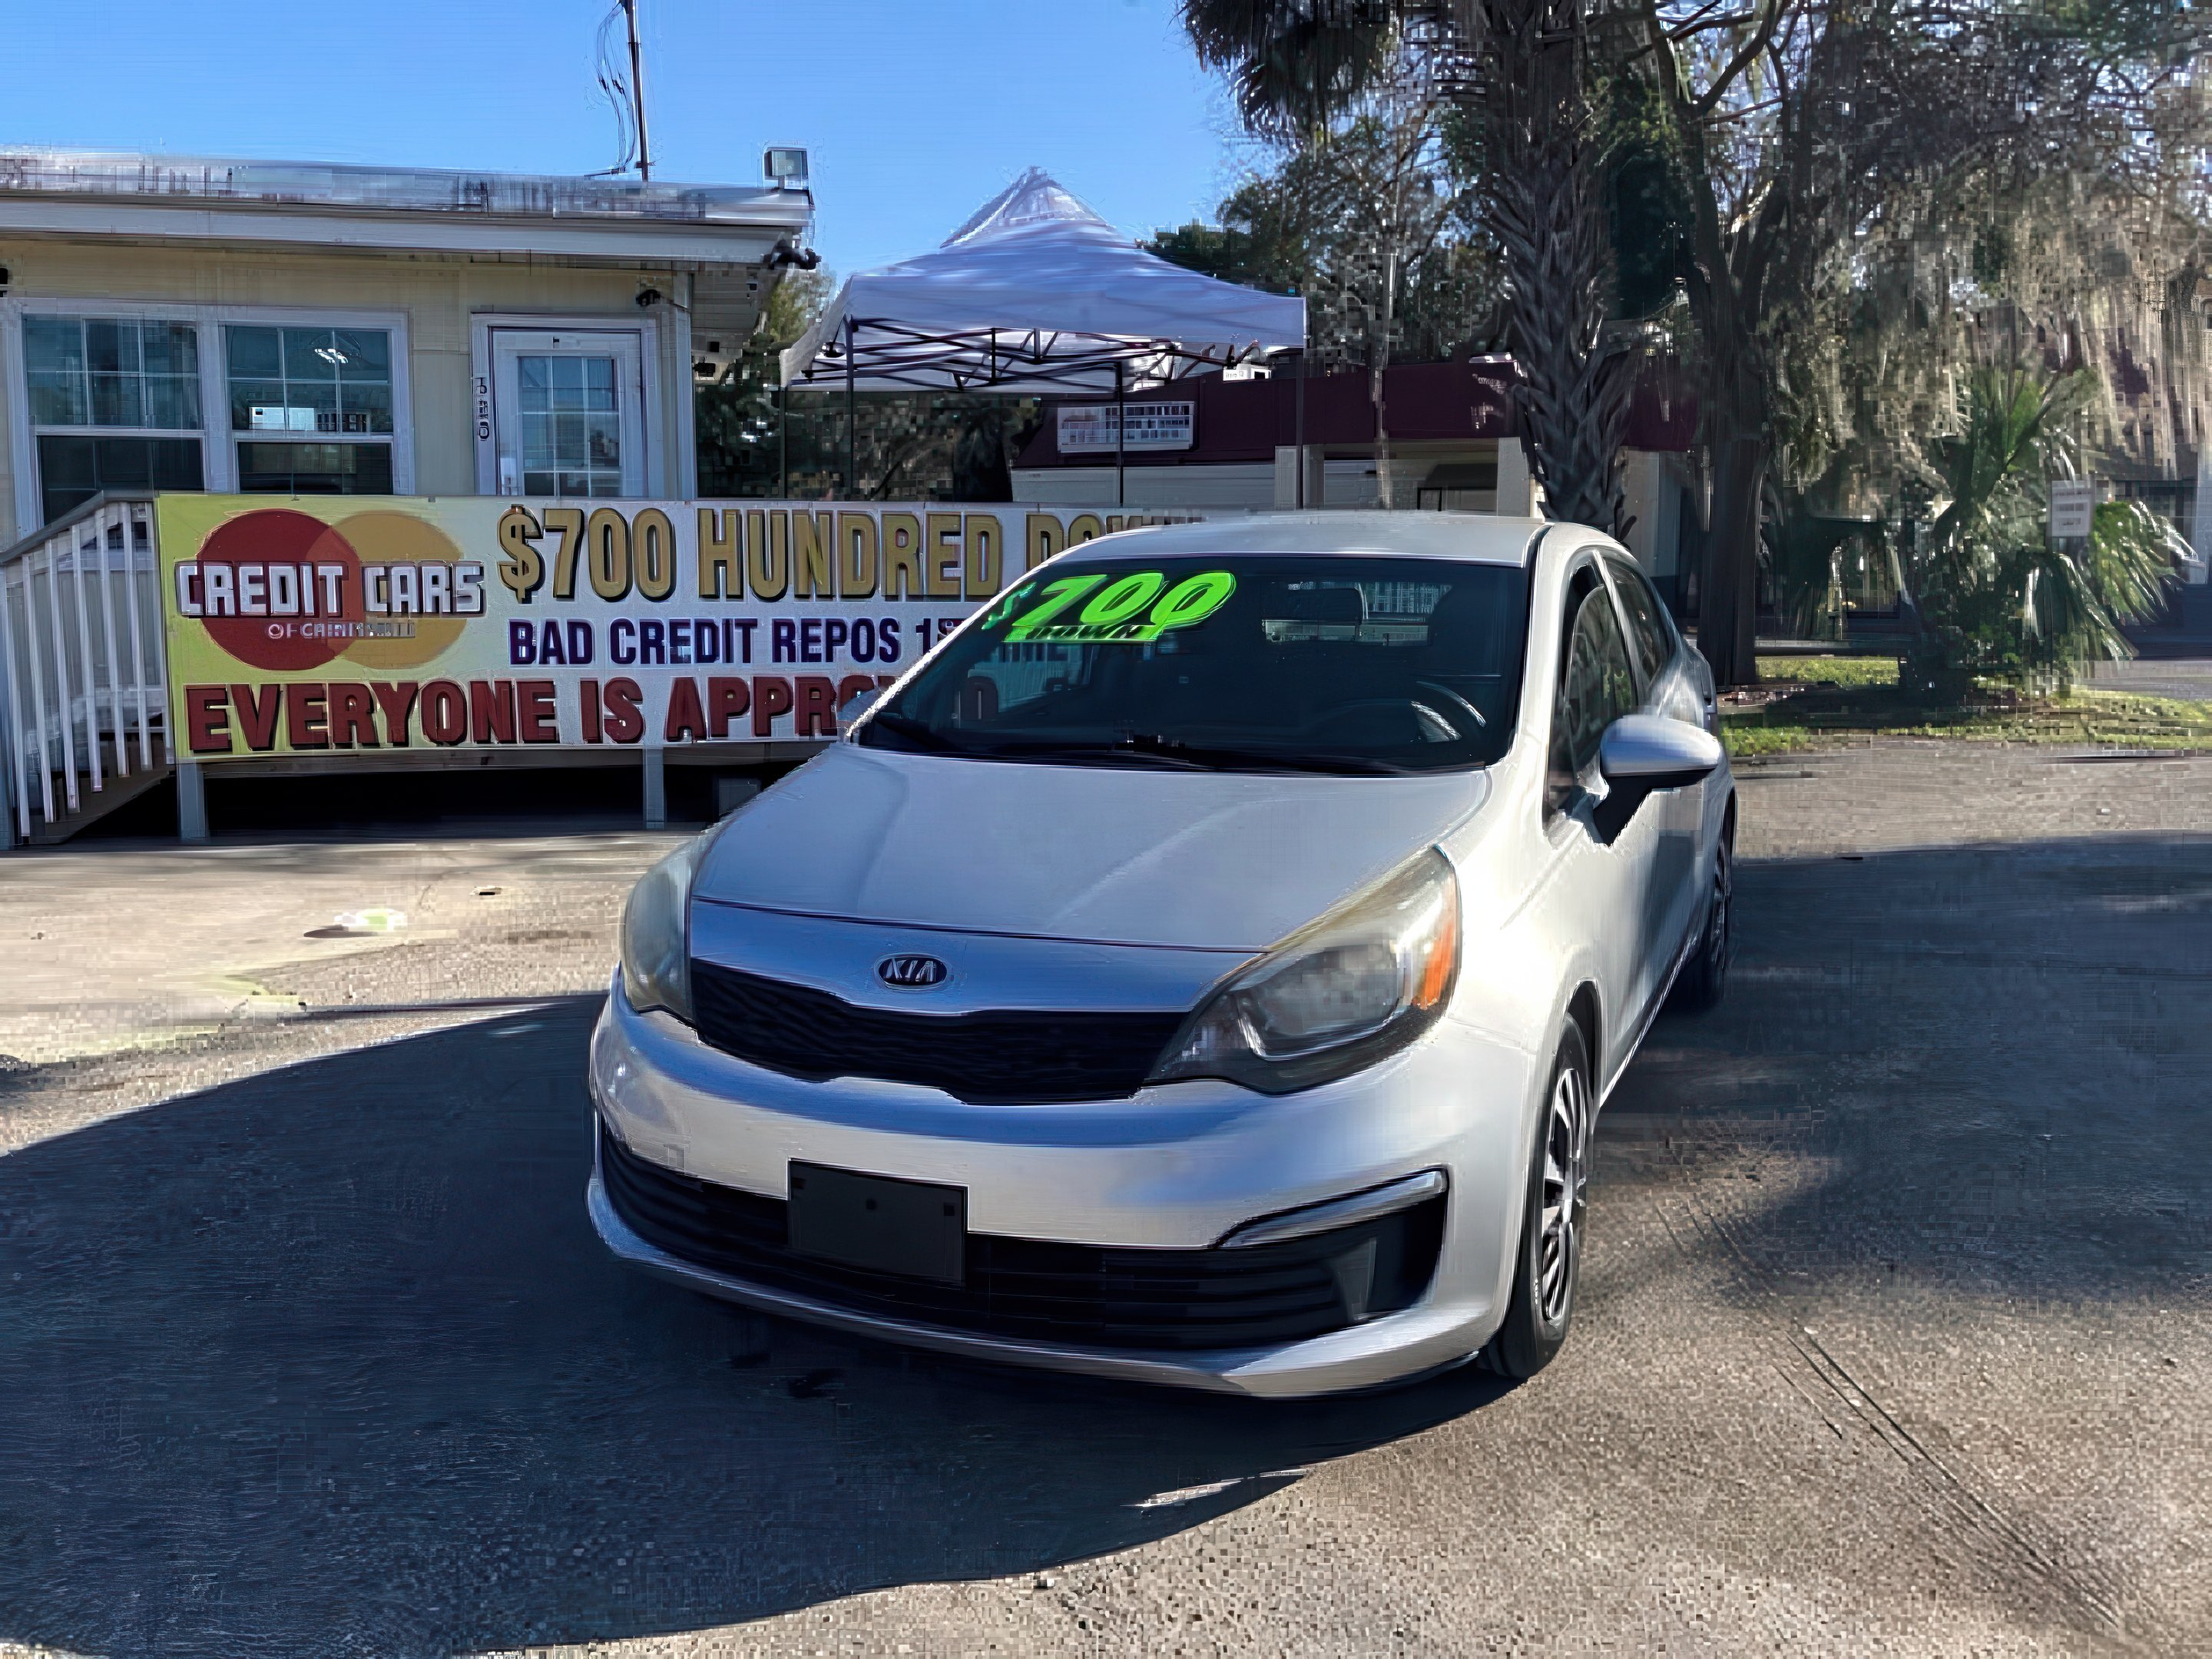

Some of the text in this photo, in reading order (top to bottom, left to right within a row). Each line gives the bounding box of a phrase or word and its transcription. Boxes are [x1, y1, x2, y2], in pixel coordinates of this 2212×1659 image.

[497, 504, 677, 604] $700
[697, 507, 1002, 601] HUNDRED
[176, 560, 487, 618] CREDIT CARS
[267, 622, 297, 639] OF
[509, 618, 594, 665] BAD
[610, 618, 758, 665] CREDIT
[772, 617, 900, 664] REPOS
[186, 680, 560, 753] EVERYONE
[580, 676, 644, 743] IS
[883, 957, 937, 982] KIA
